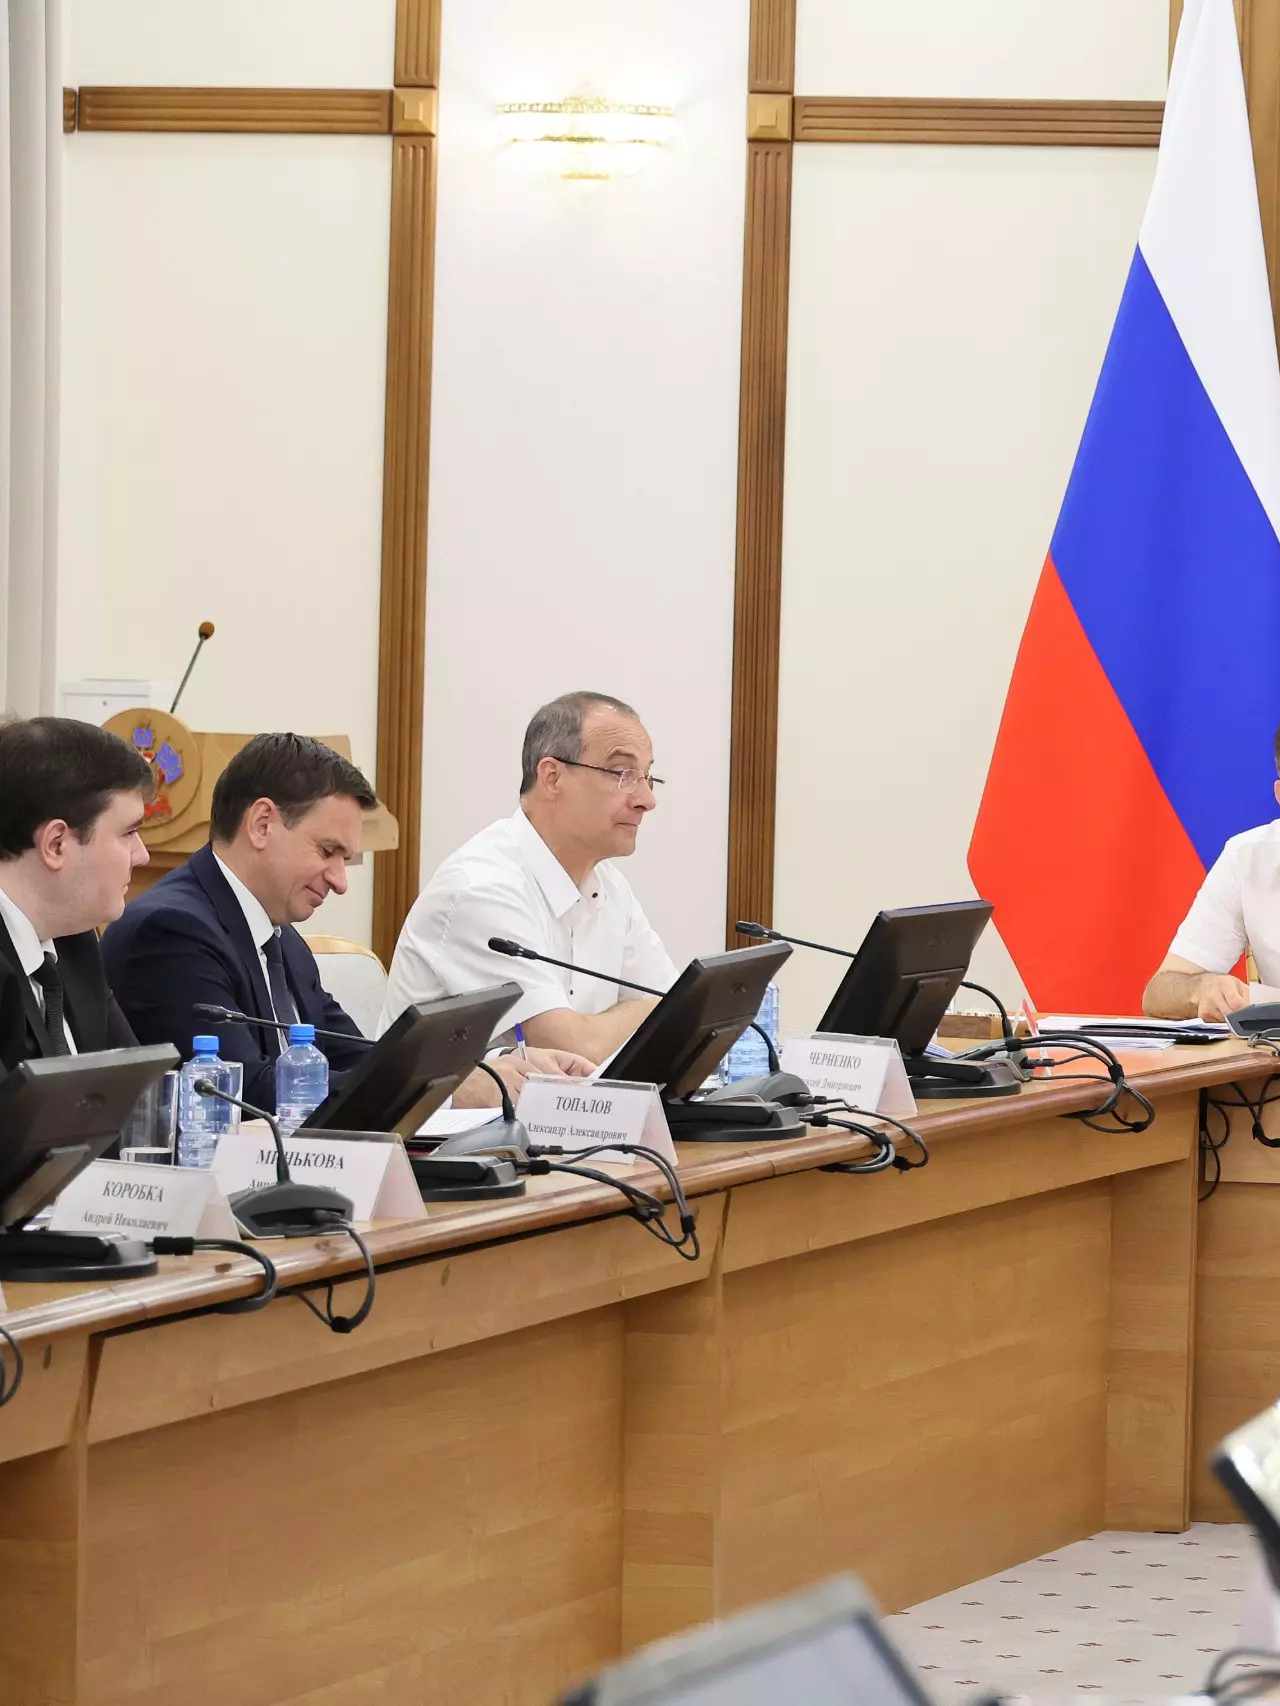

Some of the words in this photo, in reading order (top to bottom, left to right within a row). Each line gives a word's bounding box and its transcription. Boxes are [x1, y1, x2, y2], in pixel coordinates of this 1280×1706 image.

[809, 1051, 862, 1069] ЧЕРНЕНКО
[555, 1096, 613, 1115] ТОПАЛОВ
[527, 1122, 566, 1137] Александр
[568, 1125, 628, 1141] Александрович
[102, 1180, 164, 1202] КОРОБКА
[82, 1210, 113, 1227] Андрей
[114, 1213, 169, 1231] Николаевич
